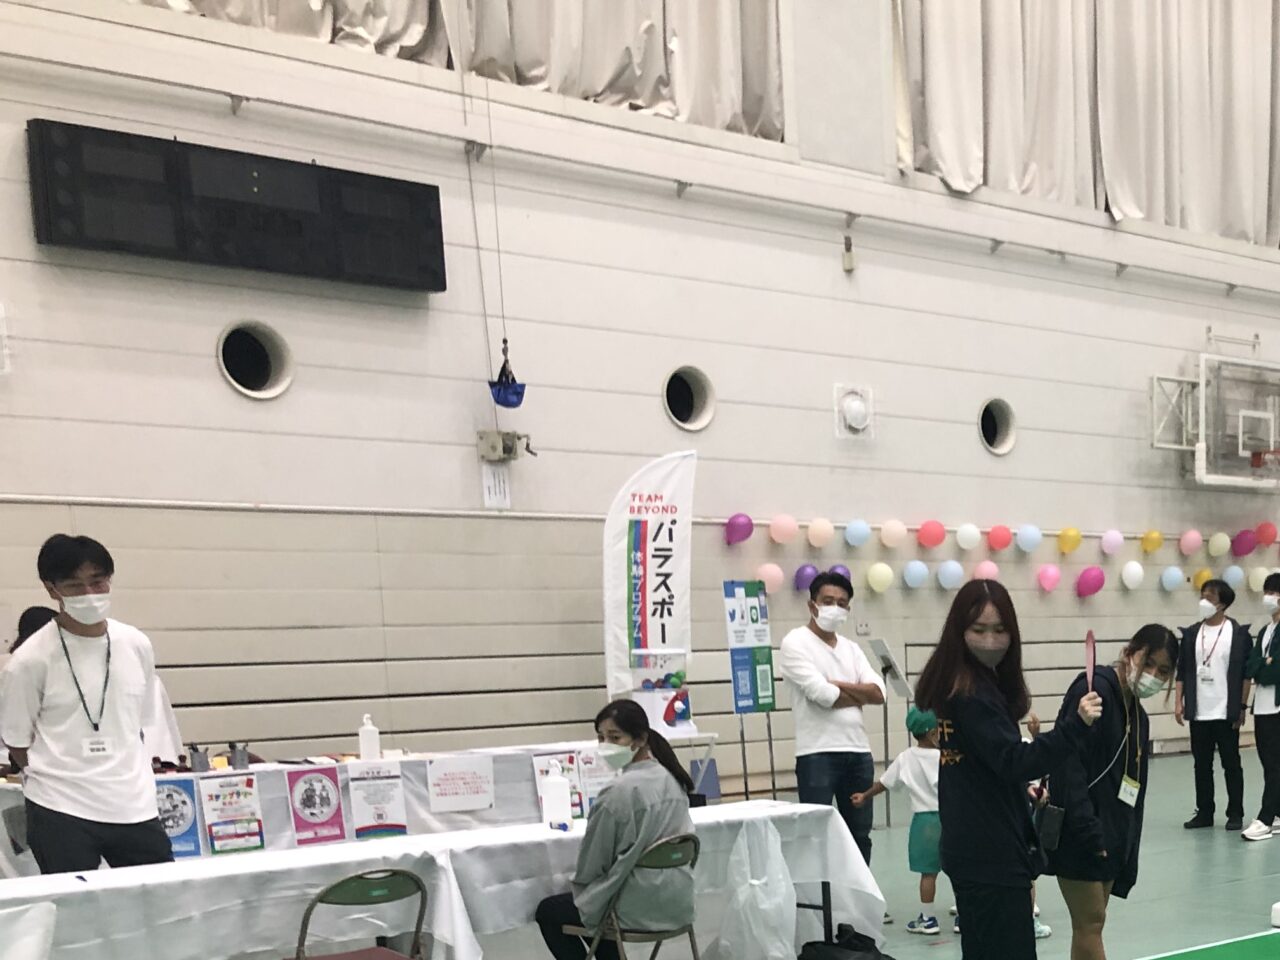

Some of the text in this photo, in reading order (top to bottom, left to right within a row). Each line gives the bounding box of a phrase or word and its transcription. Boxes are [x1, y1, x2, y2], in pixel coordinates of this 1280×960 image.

[631, 492, 664, 503] TEAM
[629, 504, 678, 515] BEYOND
[650, 518, 678, 667] パラスポー
